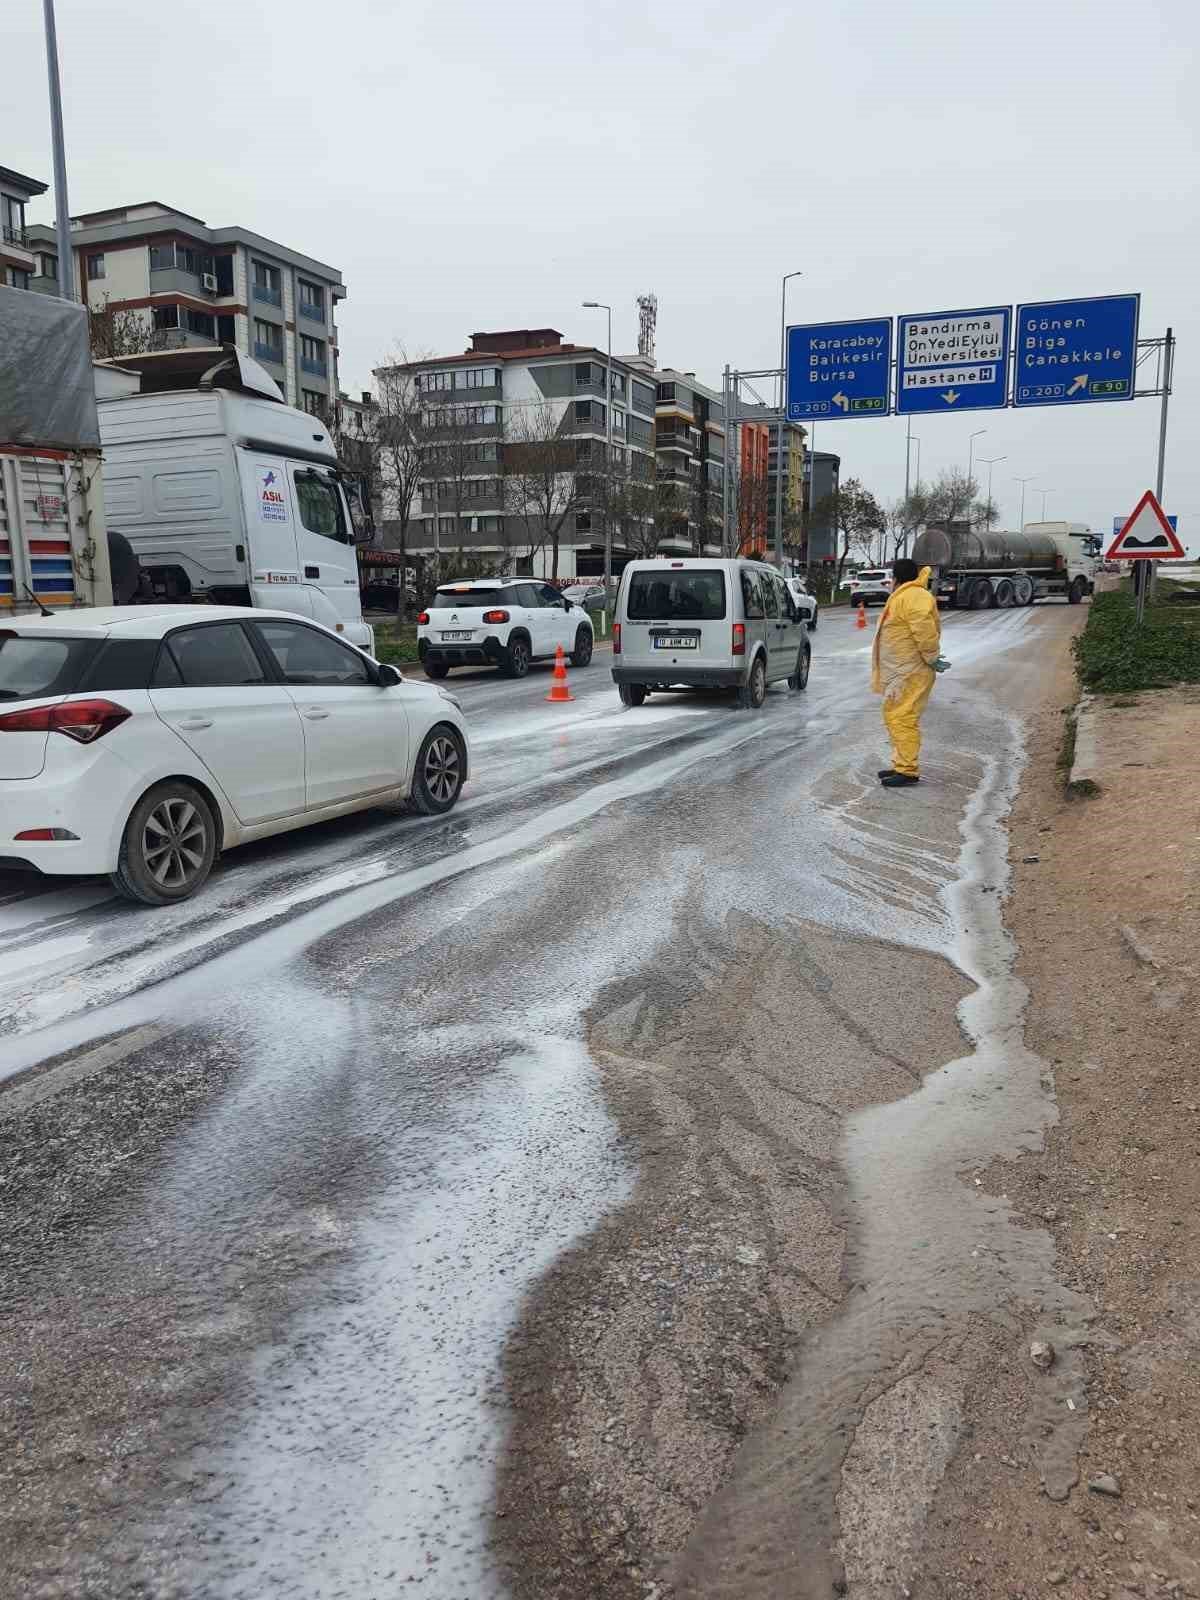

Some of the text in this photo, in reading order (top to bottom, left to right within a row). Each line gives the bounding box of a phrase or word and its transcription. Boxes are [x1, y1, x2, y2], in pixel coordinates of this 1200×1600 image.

[909, 321, 991, 336] Bandırma
[1027, 318, 1086, 332] Gönen
[809, 335, 884, 350] Karacabey
[1026, 336, 1066, 350] Biga
[809, 350, 883, 366] Balıkesir
[908, 349, 1001, 364] Üniversitesi
[1025, 347, 1122, 367] Çanakkale
[809, 370, 856, 382] Bursa
[907, 372, 976, 386] Hastane
